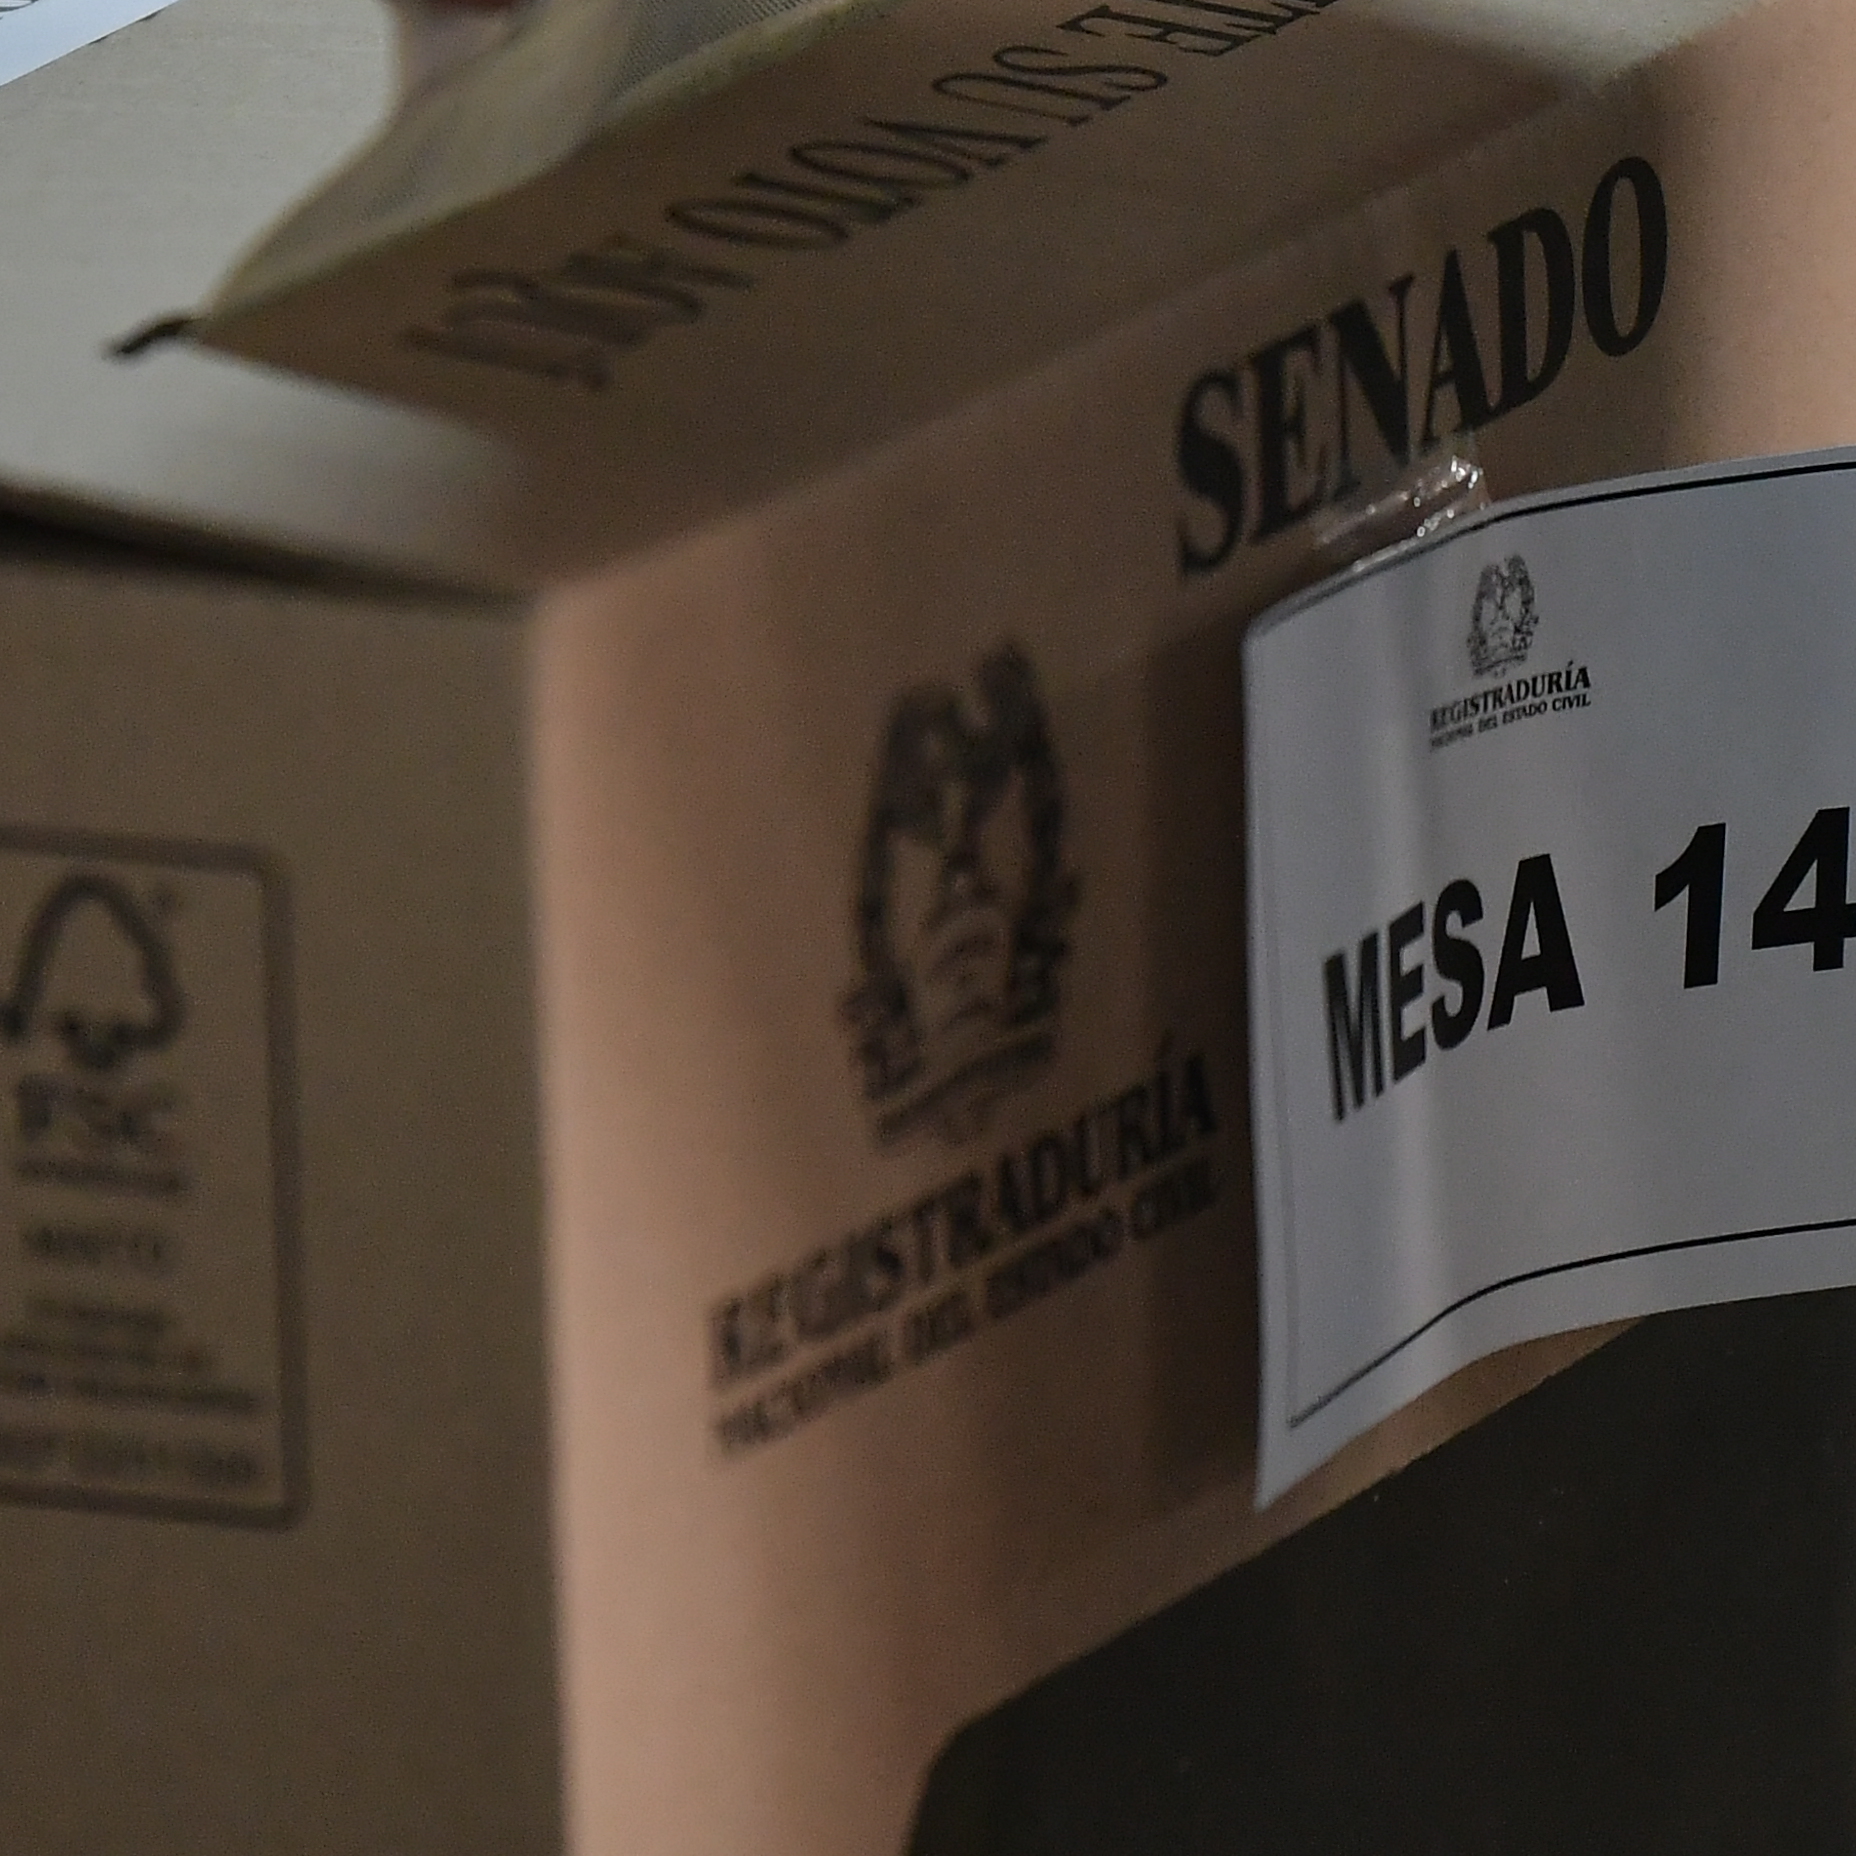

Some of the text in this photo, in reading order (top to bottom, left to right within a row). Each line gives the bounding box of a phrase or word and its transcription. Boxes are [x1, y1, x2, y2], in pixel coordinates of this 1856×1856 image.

[931, 44, 1169, 127] SU
[663, 114, 1050, 250] VOTO
[1177, 156, 1668, 576] SENADO
[1429, 659, 1592, 733] REGISTRADURÍA
[1502, 700, 1548, 725] ESTADO
[1552, 693, 1592, 713] CIVIL
[1324, 852, 1585, 1123] MESA
